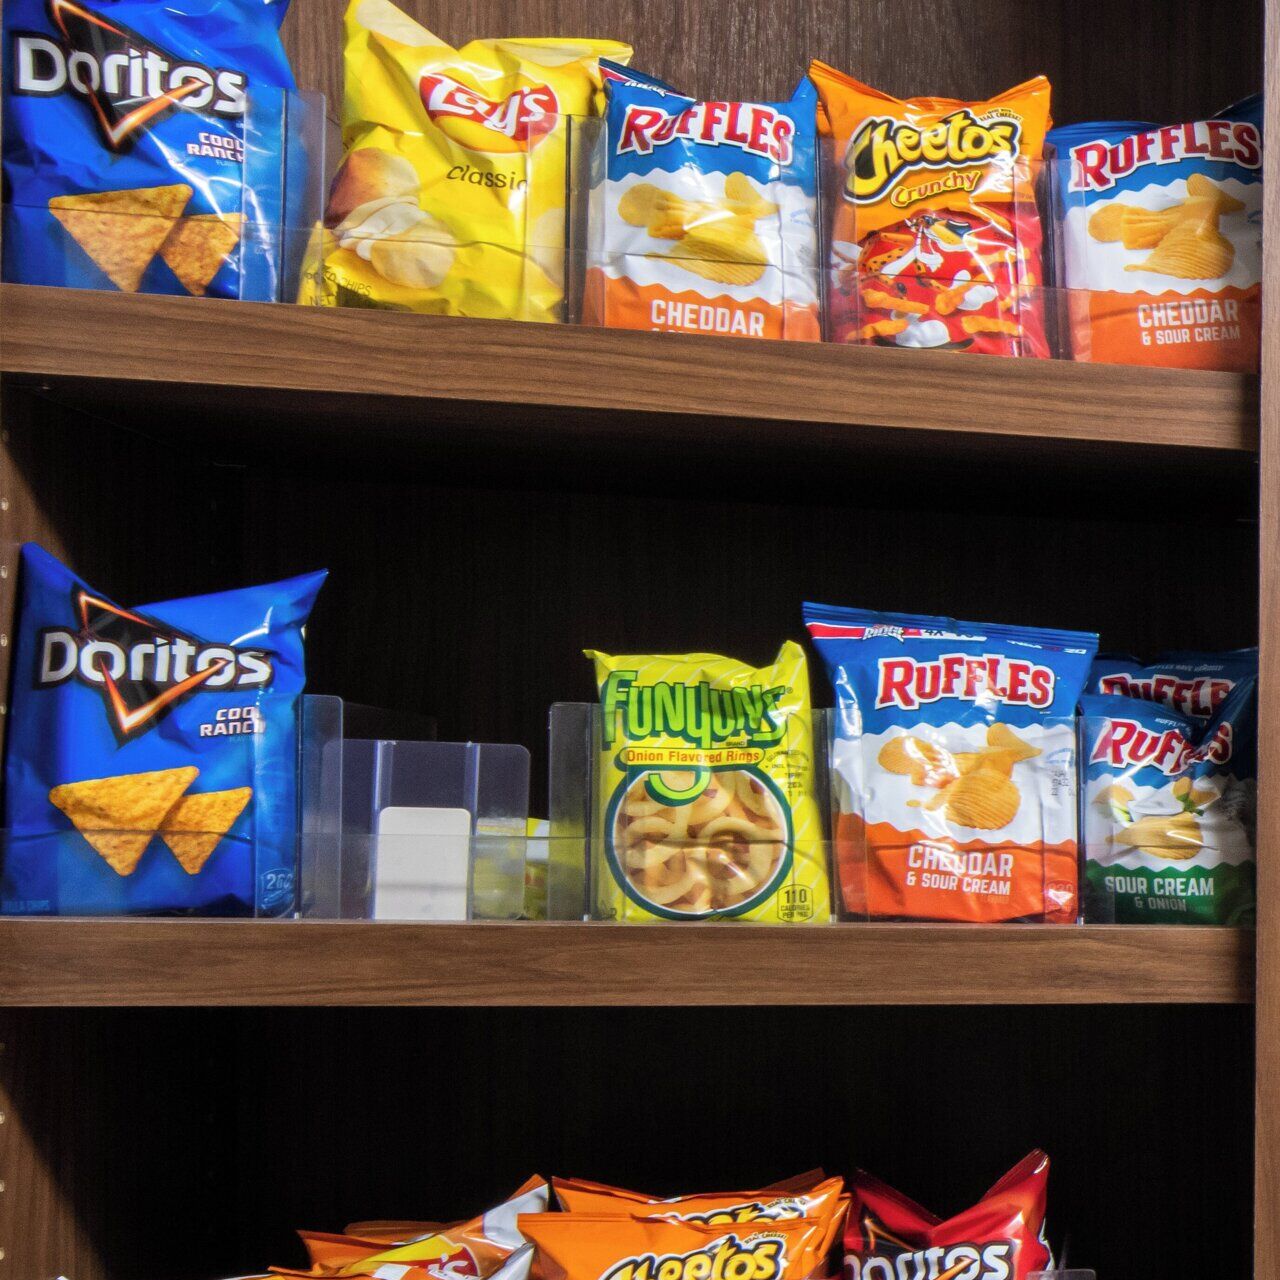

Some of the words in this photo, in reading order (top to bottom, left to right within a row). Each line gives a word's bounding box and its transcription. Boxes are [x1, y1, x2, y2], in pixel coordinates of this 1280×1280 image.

[16, 37, 245, 113] Doritos
[428, 74, 552, 136] Lay's
[619, 103, 793, 164] RUFFLES
[848, 109, 1015, 195] Cheetos
[1076, 121, 1260, 189] RUFFLES
[446, 165, 529, 192] Classic
[892, 170, 981, 206] Crunchy
[651, 299, 764, 337] CHEDDAR
[1138, 301, 1239, 325] CHEDDAR
[1142, 328, 1152, 344] &
[1157, 329, 1190, 343] SOUR
[1194, 326, 1241, 343] CREAM
[41, 632, 272, 686] Doritos
[878, 655, 1053, 708] RUFFLES
[200, 720, 266, 737] RANCH
[215, 706, 259, 722] COOL
[627, 751, 664, 762] Onion
[668, 751, 722, 764] Flavored
[726, 751, 760, 764] Rings
[908, 846, 1014, 878] CHEDDAR
[906, 871, 916, 886] &
[921, 875, 958, 891] SOUR
[962, 878, 1011, 896] CREAM
[1105, 877, 1147, 895] SOUR
[1153, 878, 1214, 896] CREAM
[1147, 897, 1187, 911] ONION
